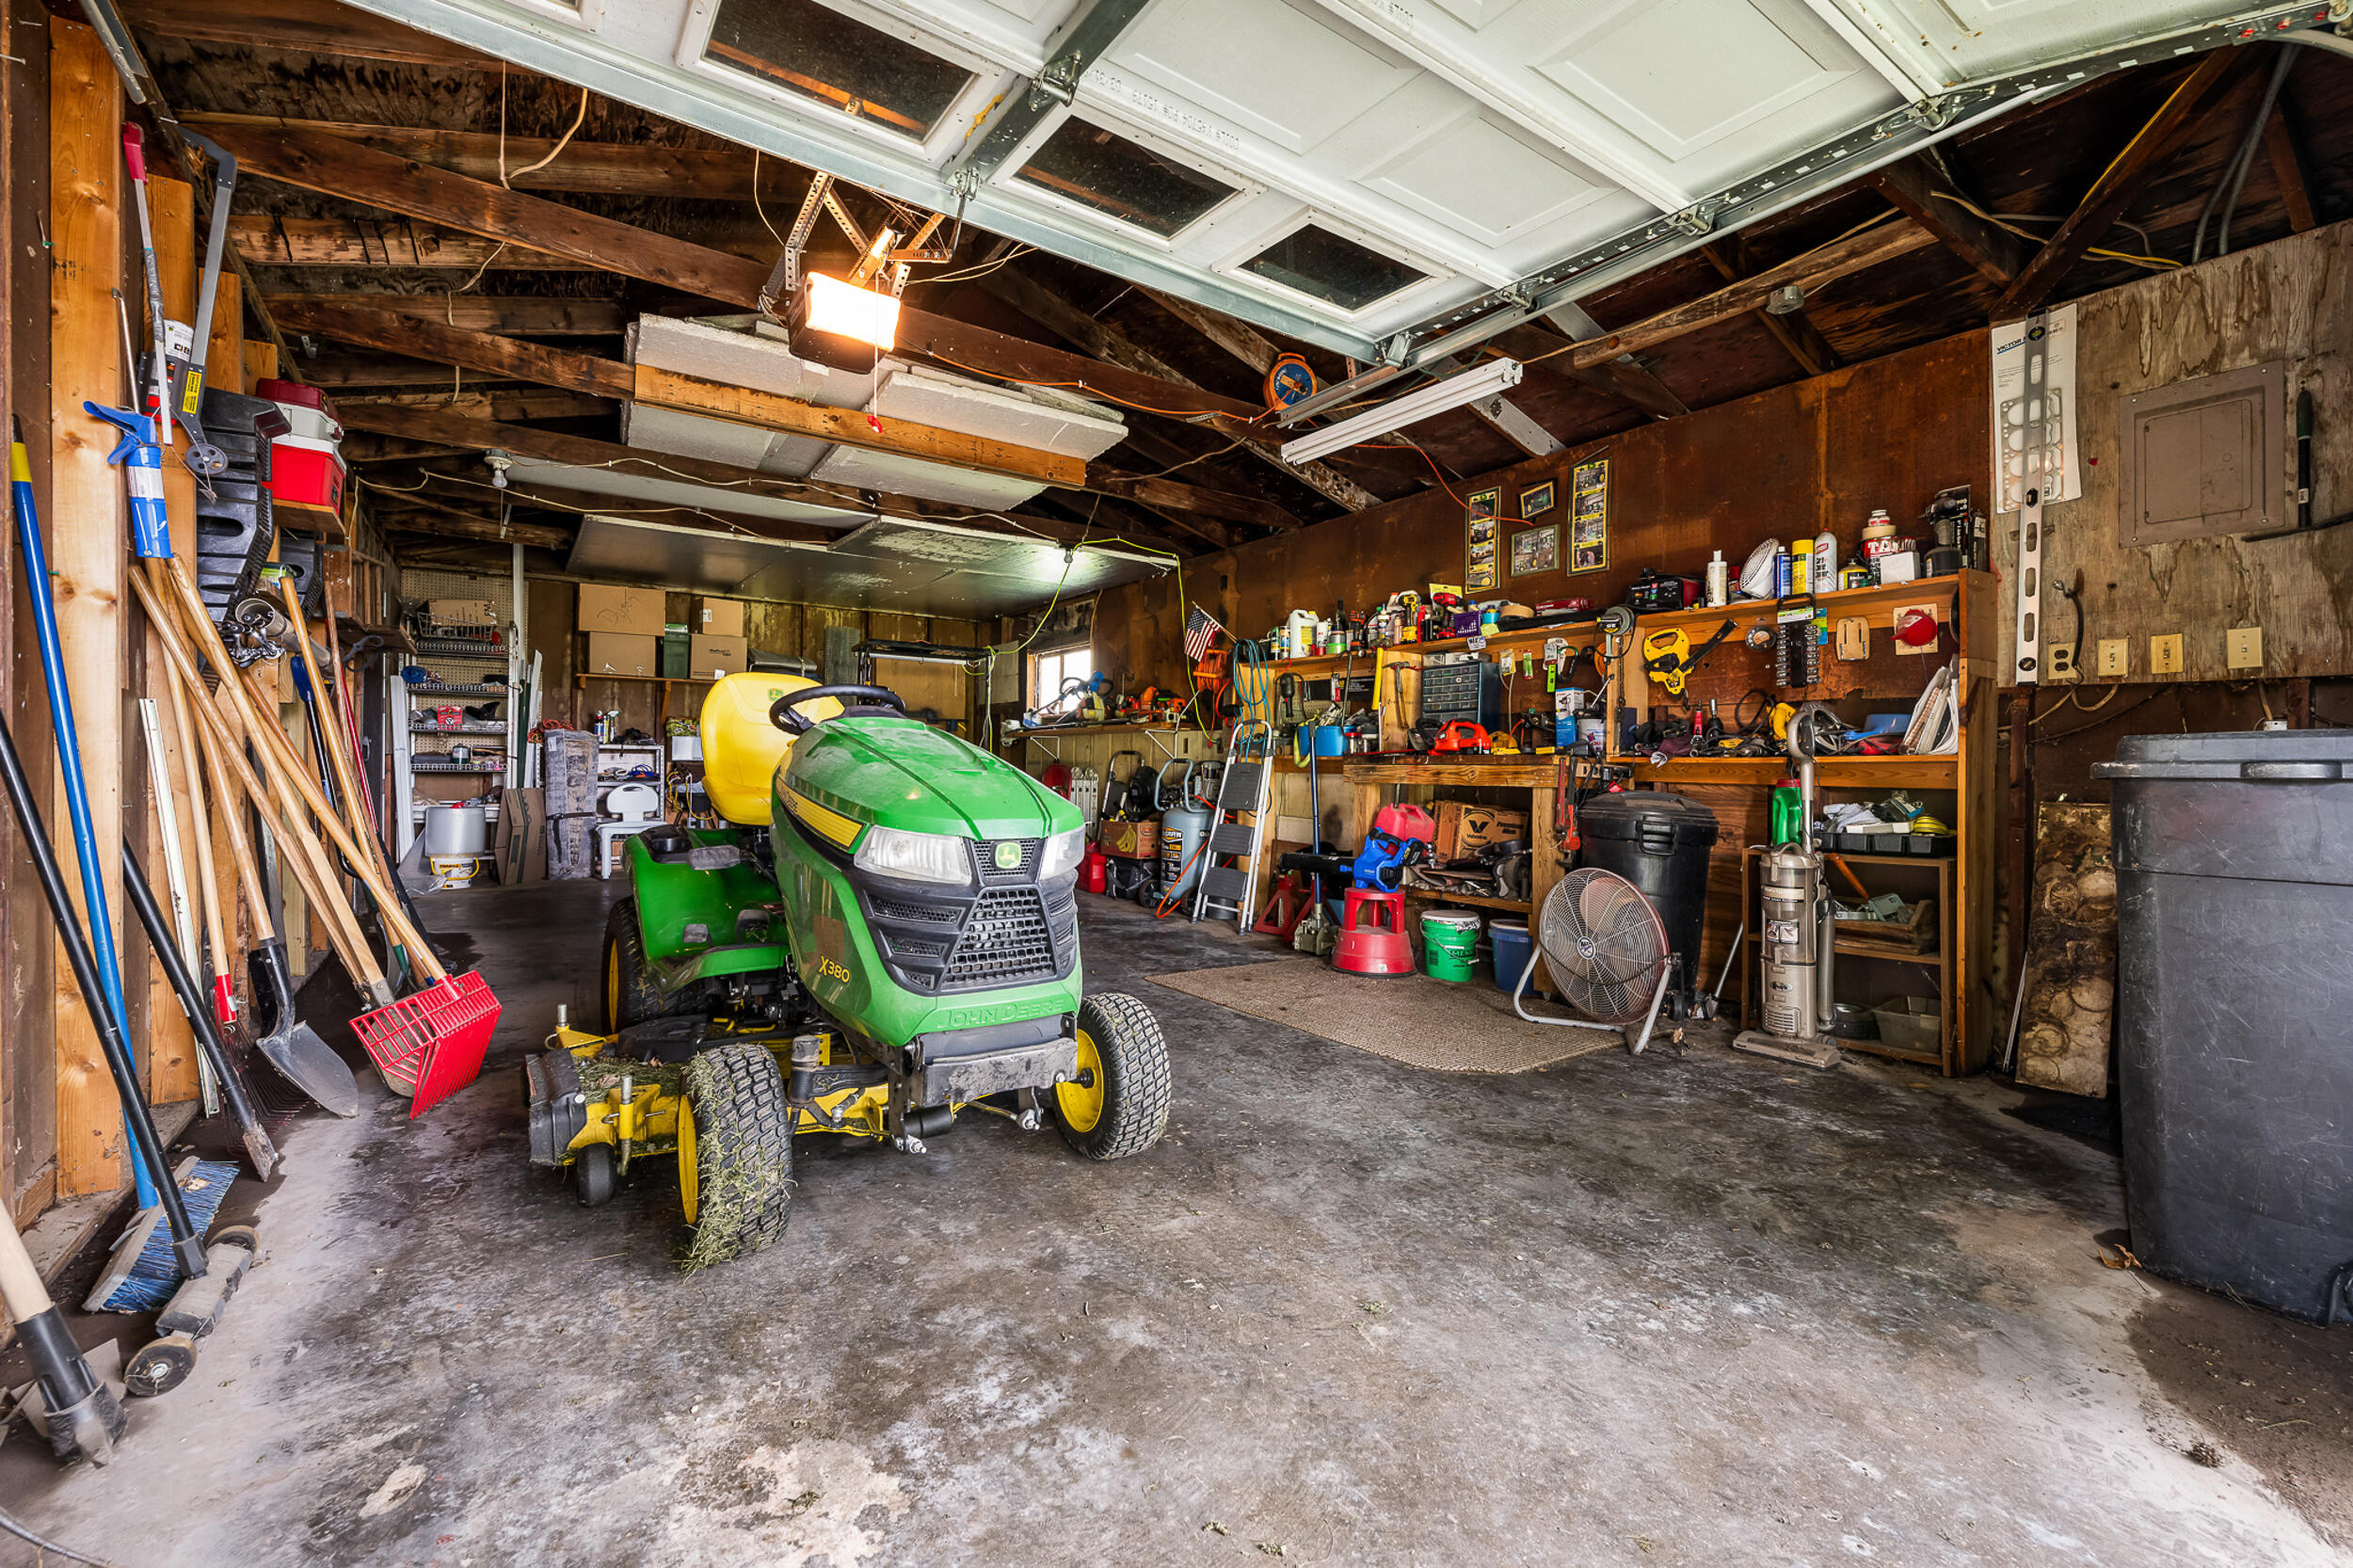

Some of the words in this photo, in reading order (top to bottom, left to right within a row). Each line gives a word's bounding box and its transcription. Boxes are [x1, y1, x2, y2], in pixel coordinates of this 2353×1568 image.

[819, 955, 850, 984] X380
[936, 1008, 998, 1029] JOHN
[1001, 999, 1064, 1021] DEERE
